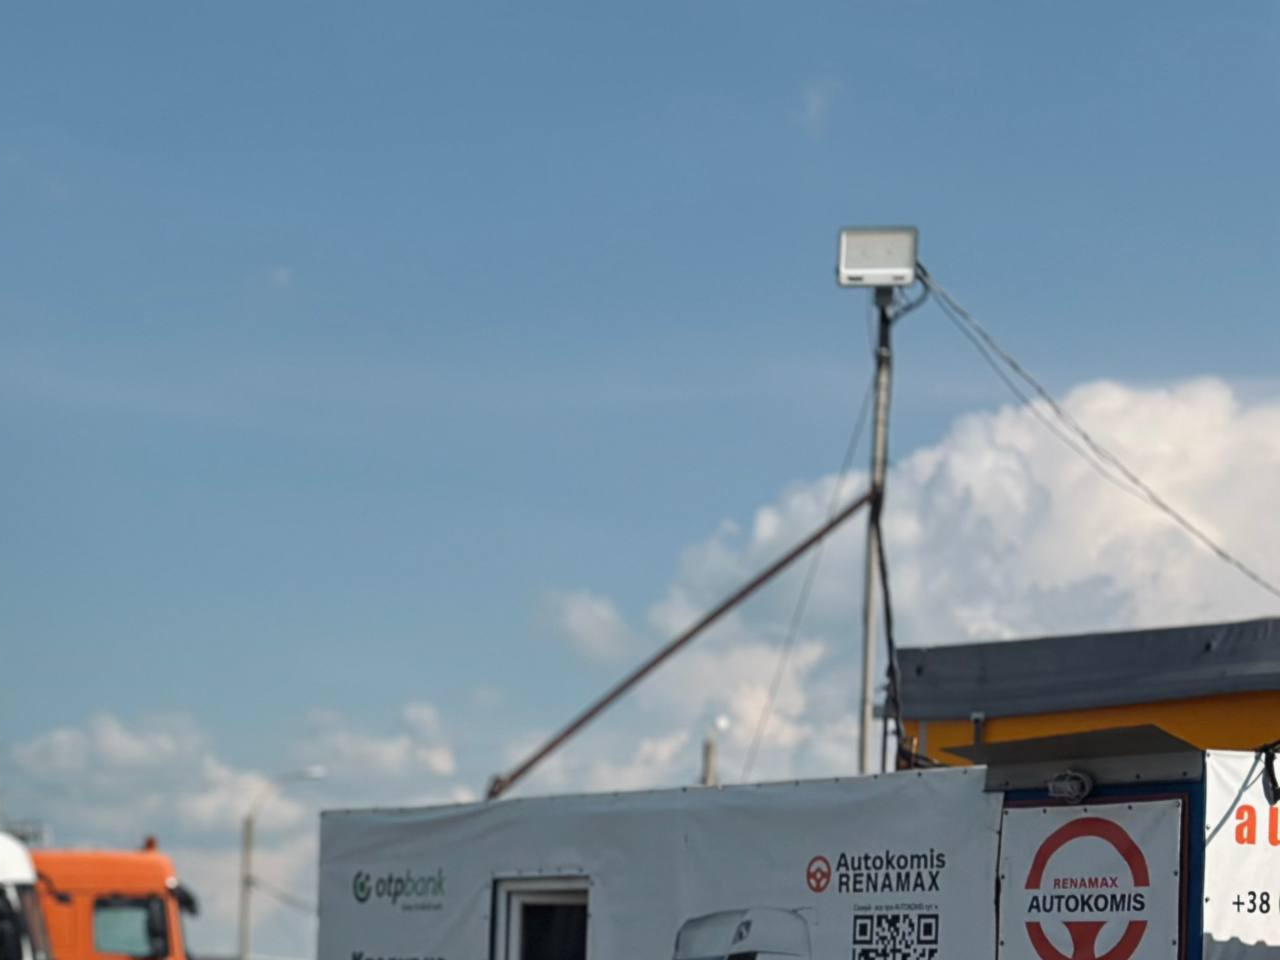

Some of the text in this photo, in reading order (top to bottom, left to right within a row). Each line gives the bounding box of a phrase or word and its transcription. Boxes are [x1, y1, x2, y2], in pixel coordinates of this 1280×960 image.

[836, 848, 946, 872] Autokomis
[838, 871, 940, 894] RENAMAX
[1053, 877, 1119, 890] RENAMAX
[1027, 893, 1146, 913] AUTOKOMIS
[1232, 891, 1271, 914] +38
